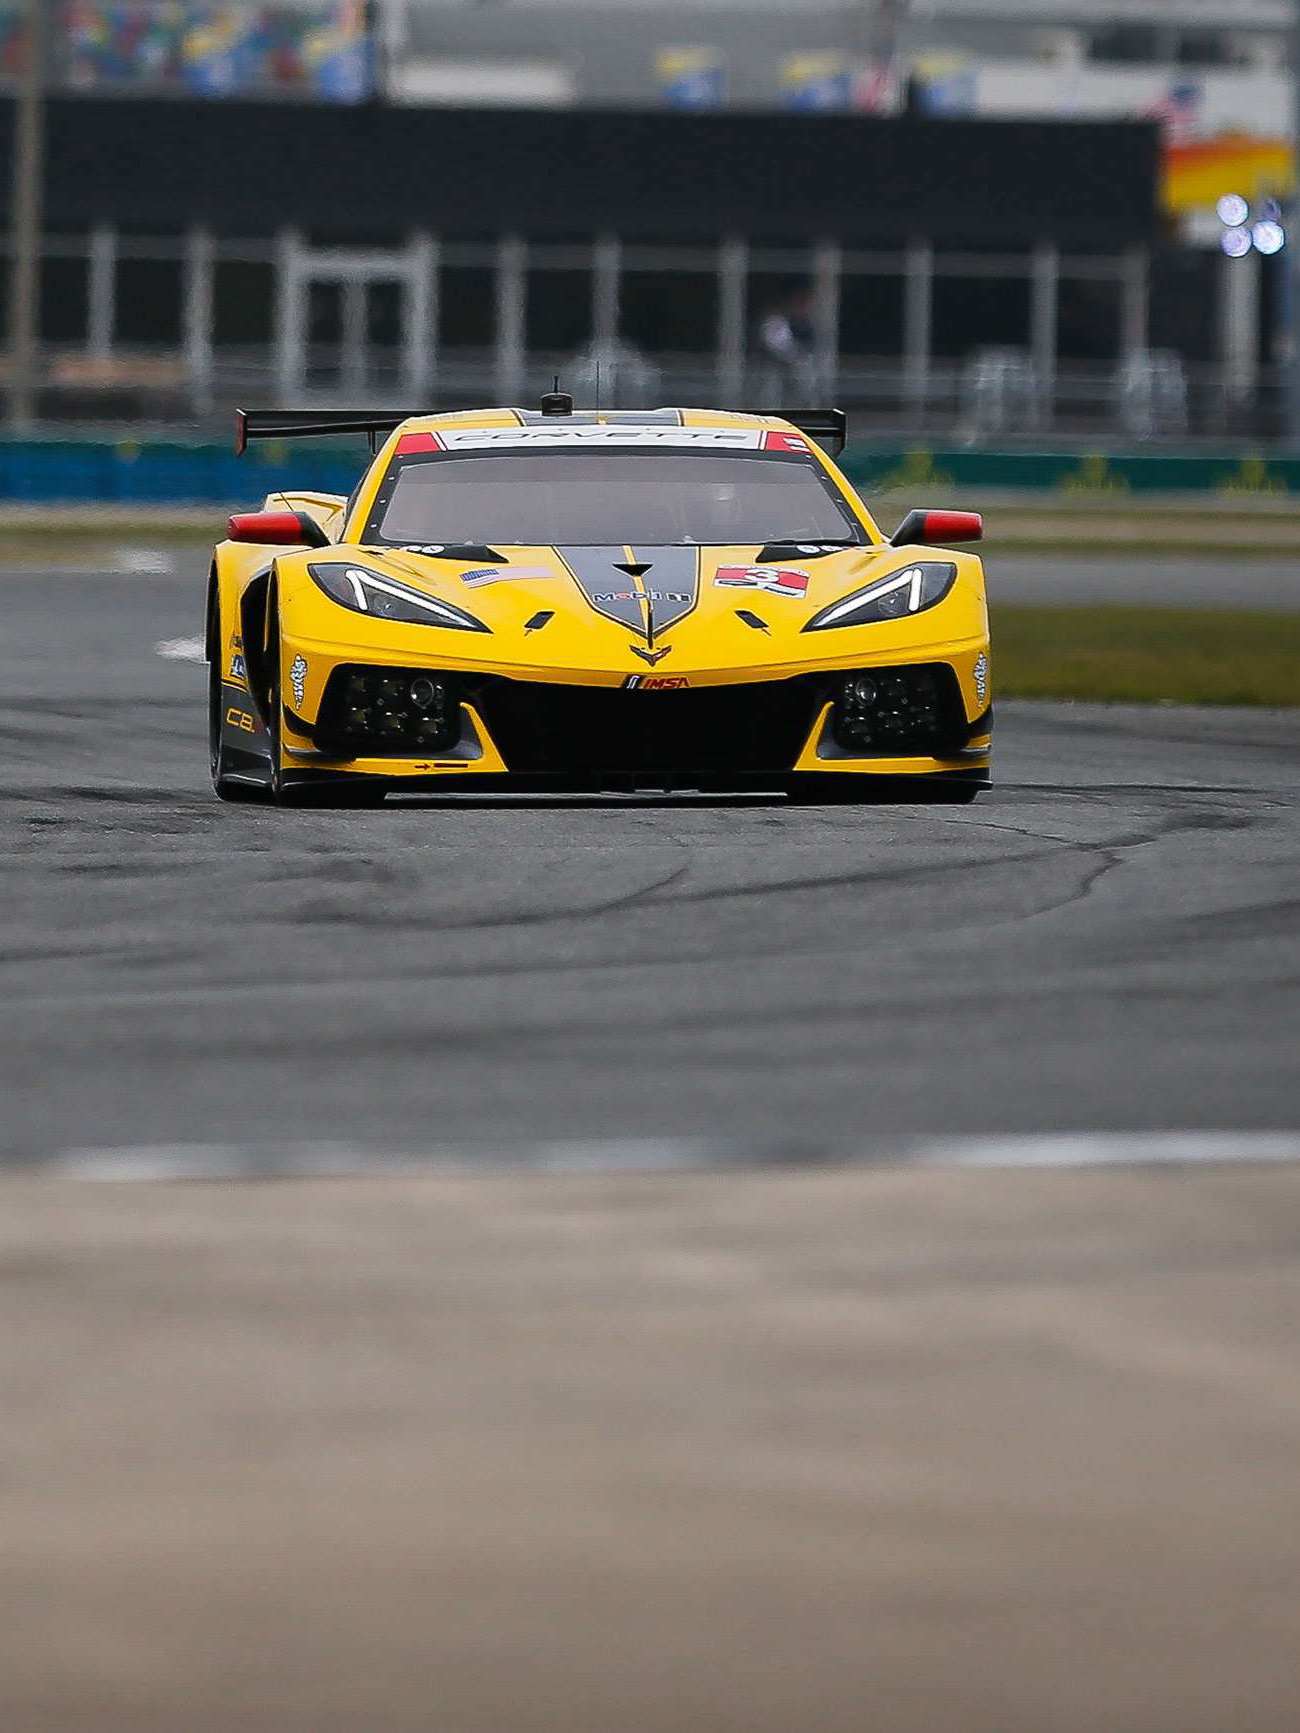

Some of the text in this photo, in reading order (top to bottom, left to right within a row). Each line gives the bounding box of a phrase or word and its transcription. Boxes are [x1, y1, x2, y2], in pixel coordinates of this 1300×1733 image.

[454, 432, 748, 441] CORVETTE
[744, 567, 780, 584] 3
[593, 590, 662, 602] Mobil
[643, 677, 690, 689] IMSA
